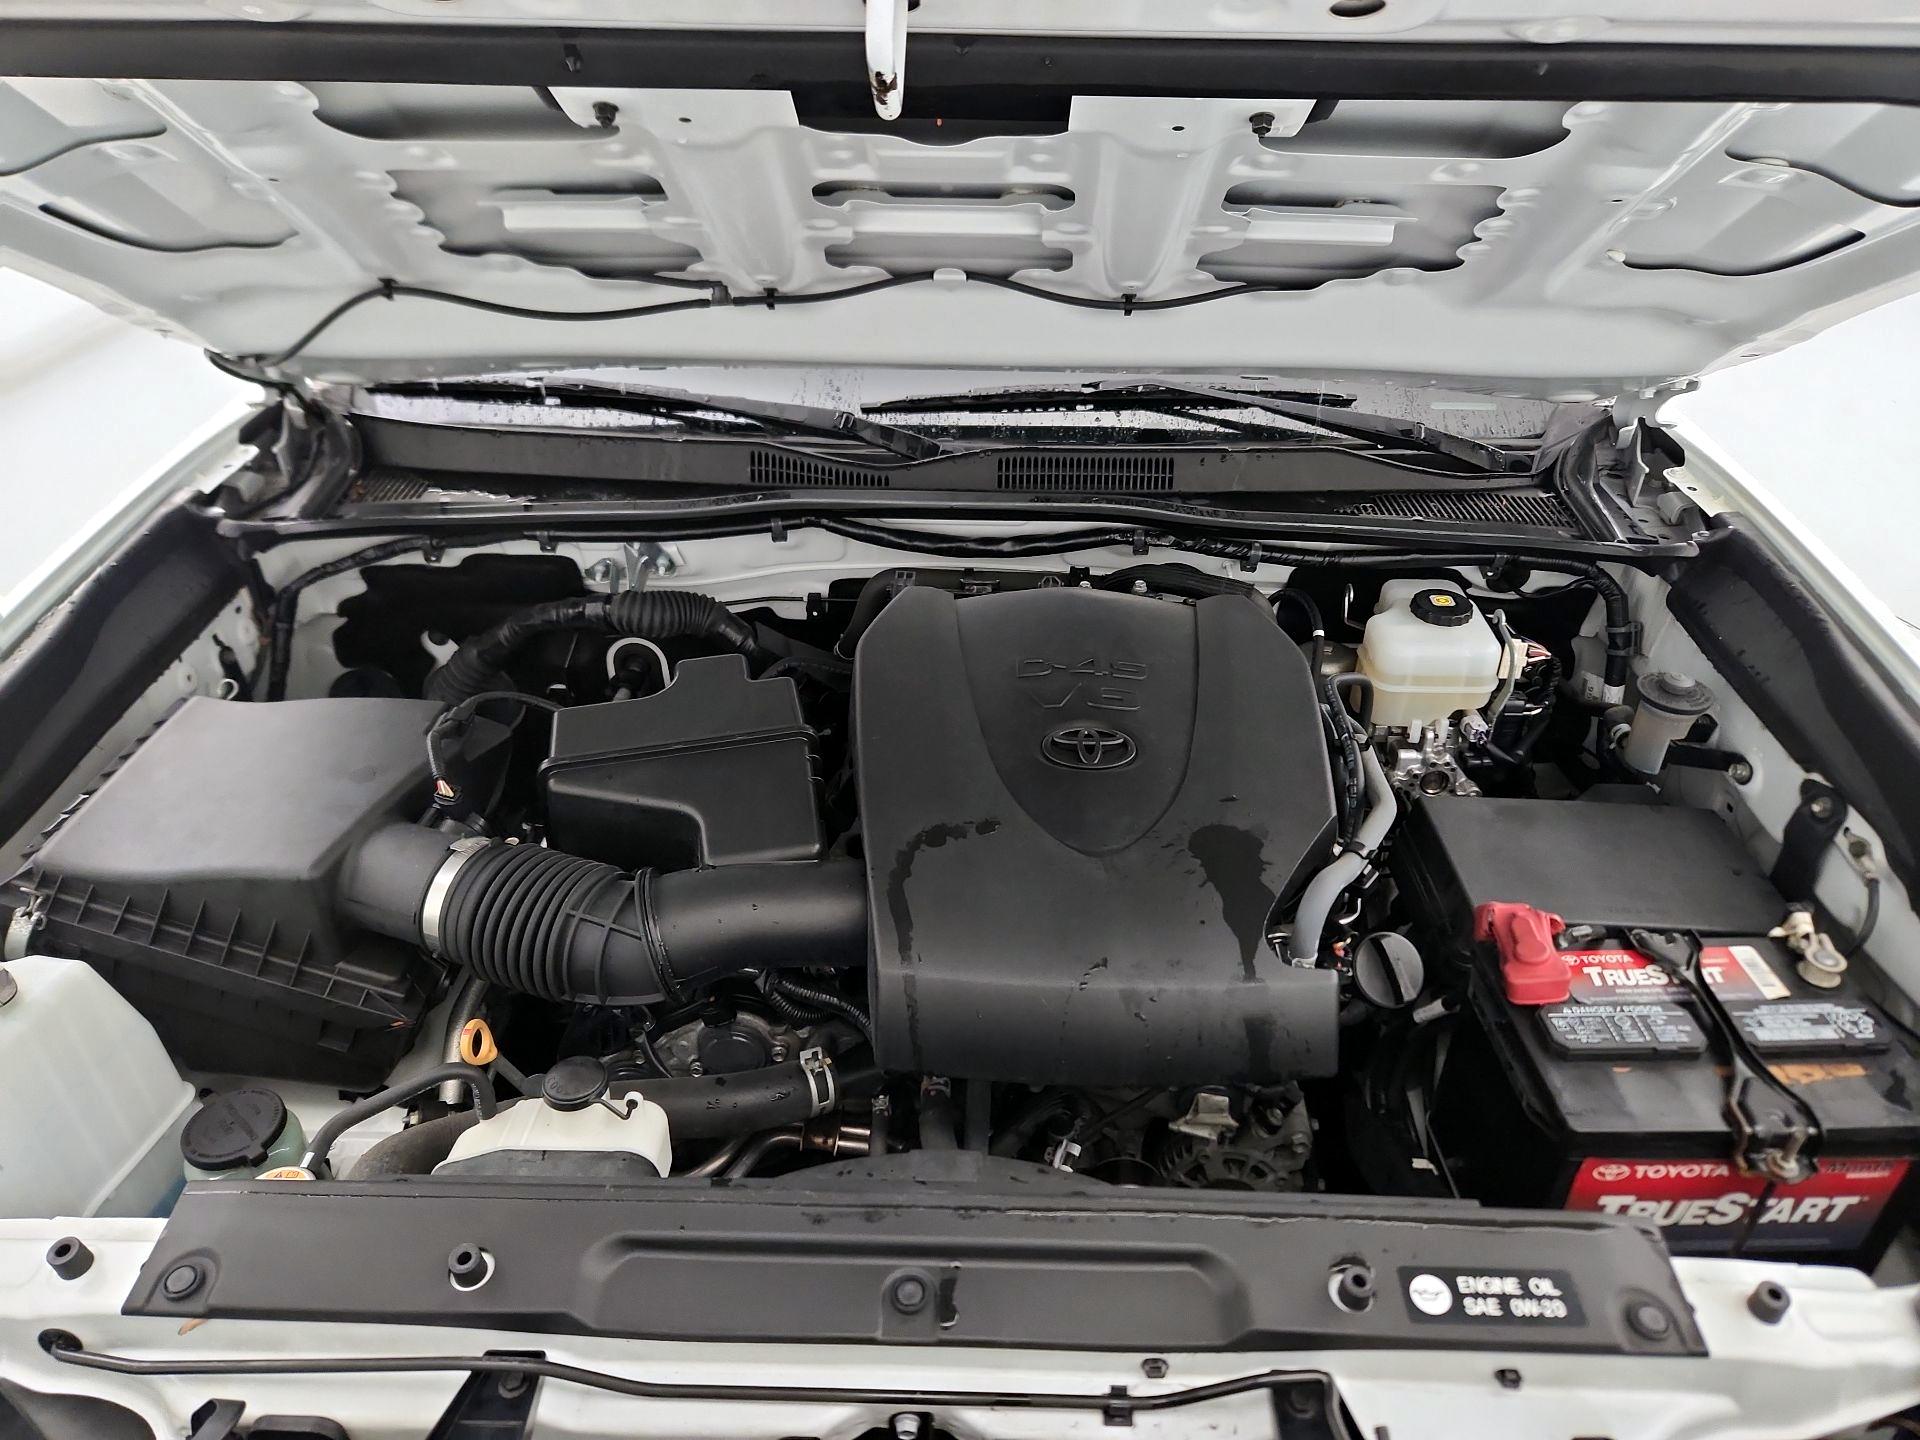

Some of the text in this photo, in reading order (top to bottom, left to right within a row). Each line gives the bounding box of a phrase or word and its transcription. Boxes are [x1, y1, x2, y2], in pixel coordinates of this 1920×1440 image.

[1579, 954, 1634, 966] TOYOTA
[1634, 1163, 1730, 1180] TOYOTA
[1456, 1275, 1563, 1297] ENGINE OIL
[1463, 1296, 1504, 1317] SAE
